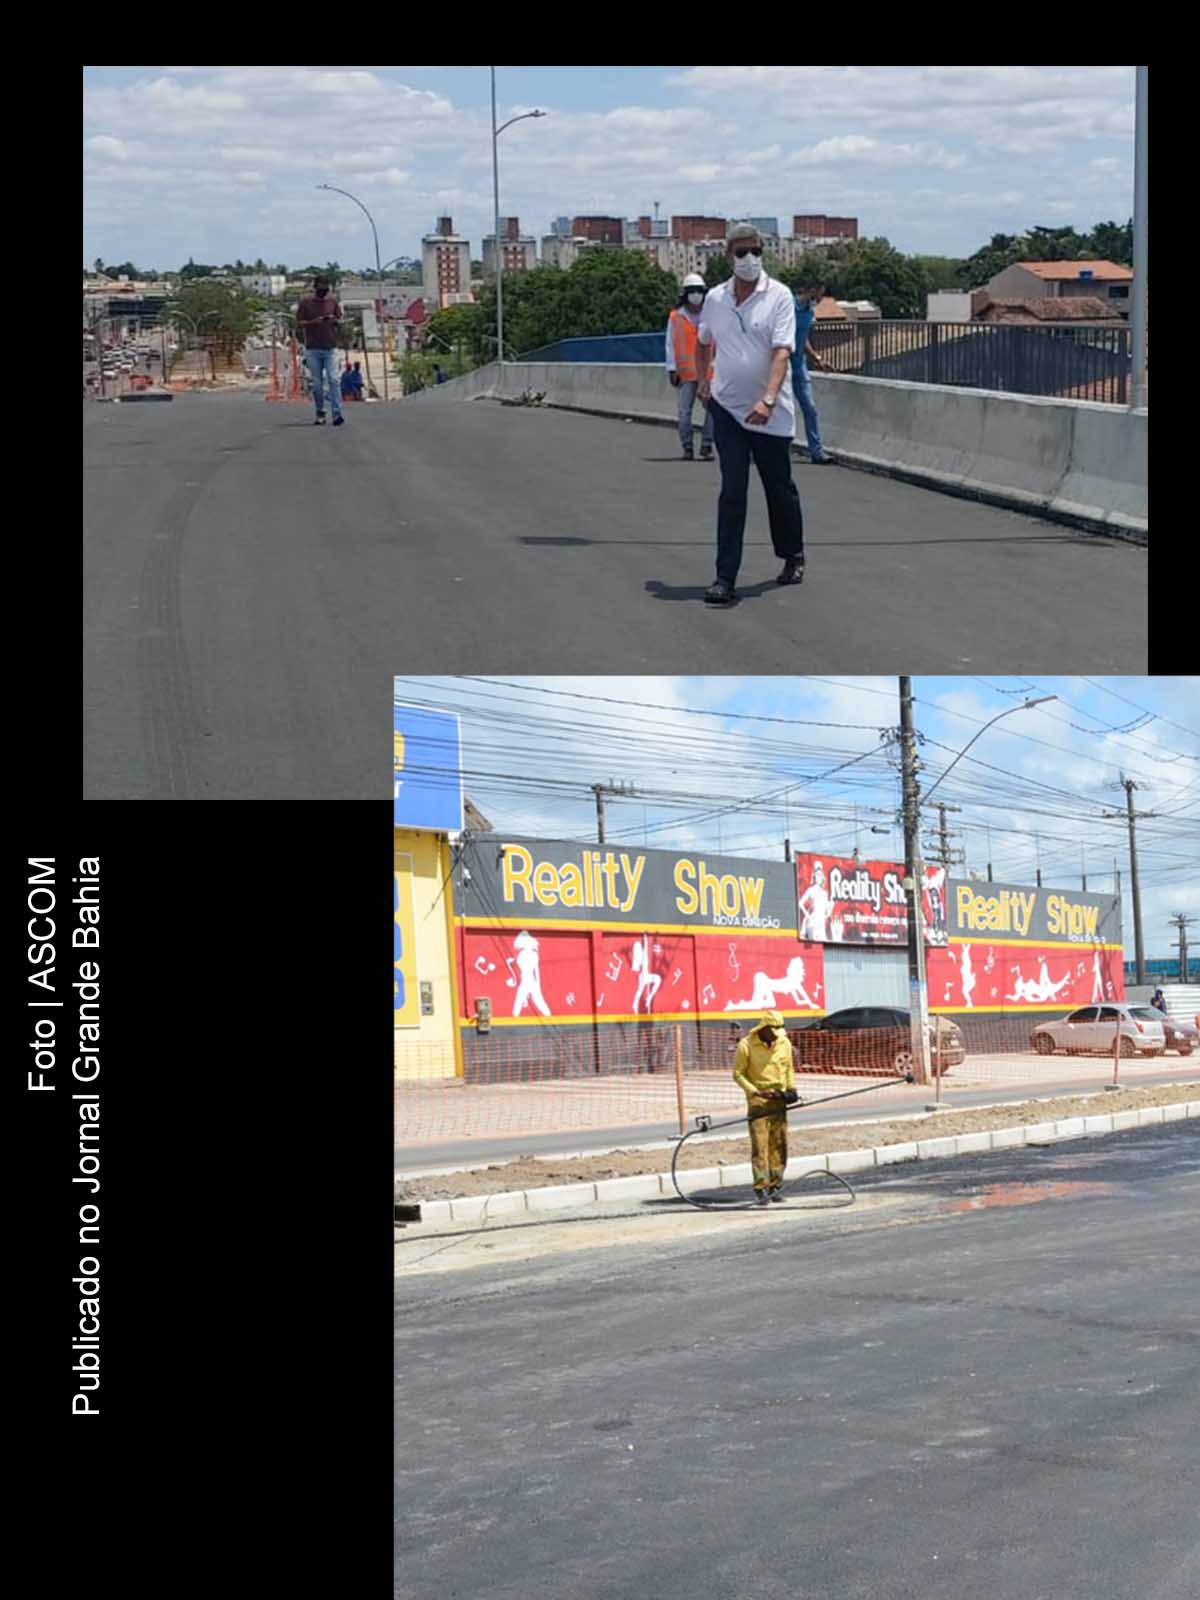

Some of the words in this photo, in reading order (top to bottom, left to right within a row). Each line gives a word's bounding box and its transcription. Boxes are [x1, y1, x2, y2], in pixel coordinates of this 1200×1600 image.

[500, 844, 646, 913] Reality
[673, 858, 764, 918] Show
[829, 867, 882, 912] Reality
[883, 873, 908, 904] Sh
[956, 885, 1036, 936] Reality
[1046, 894, 1099, 936] Show
